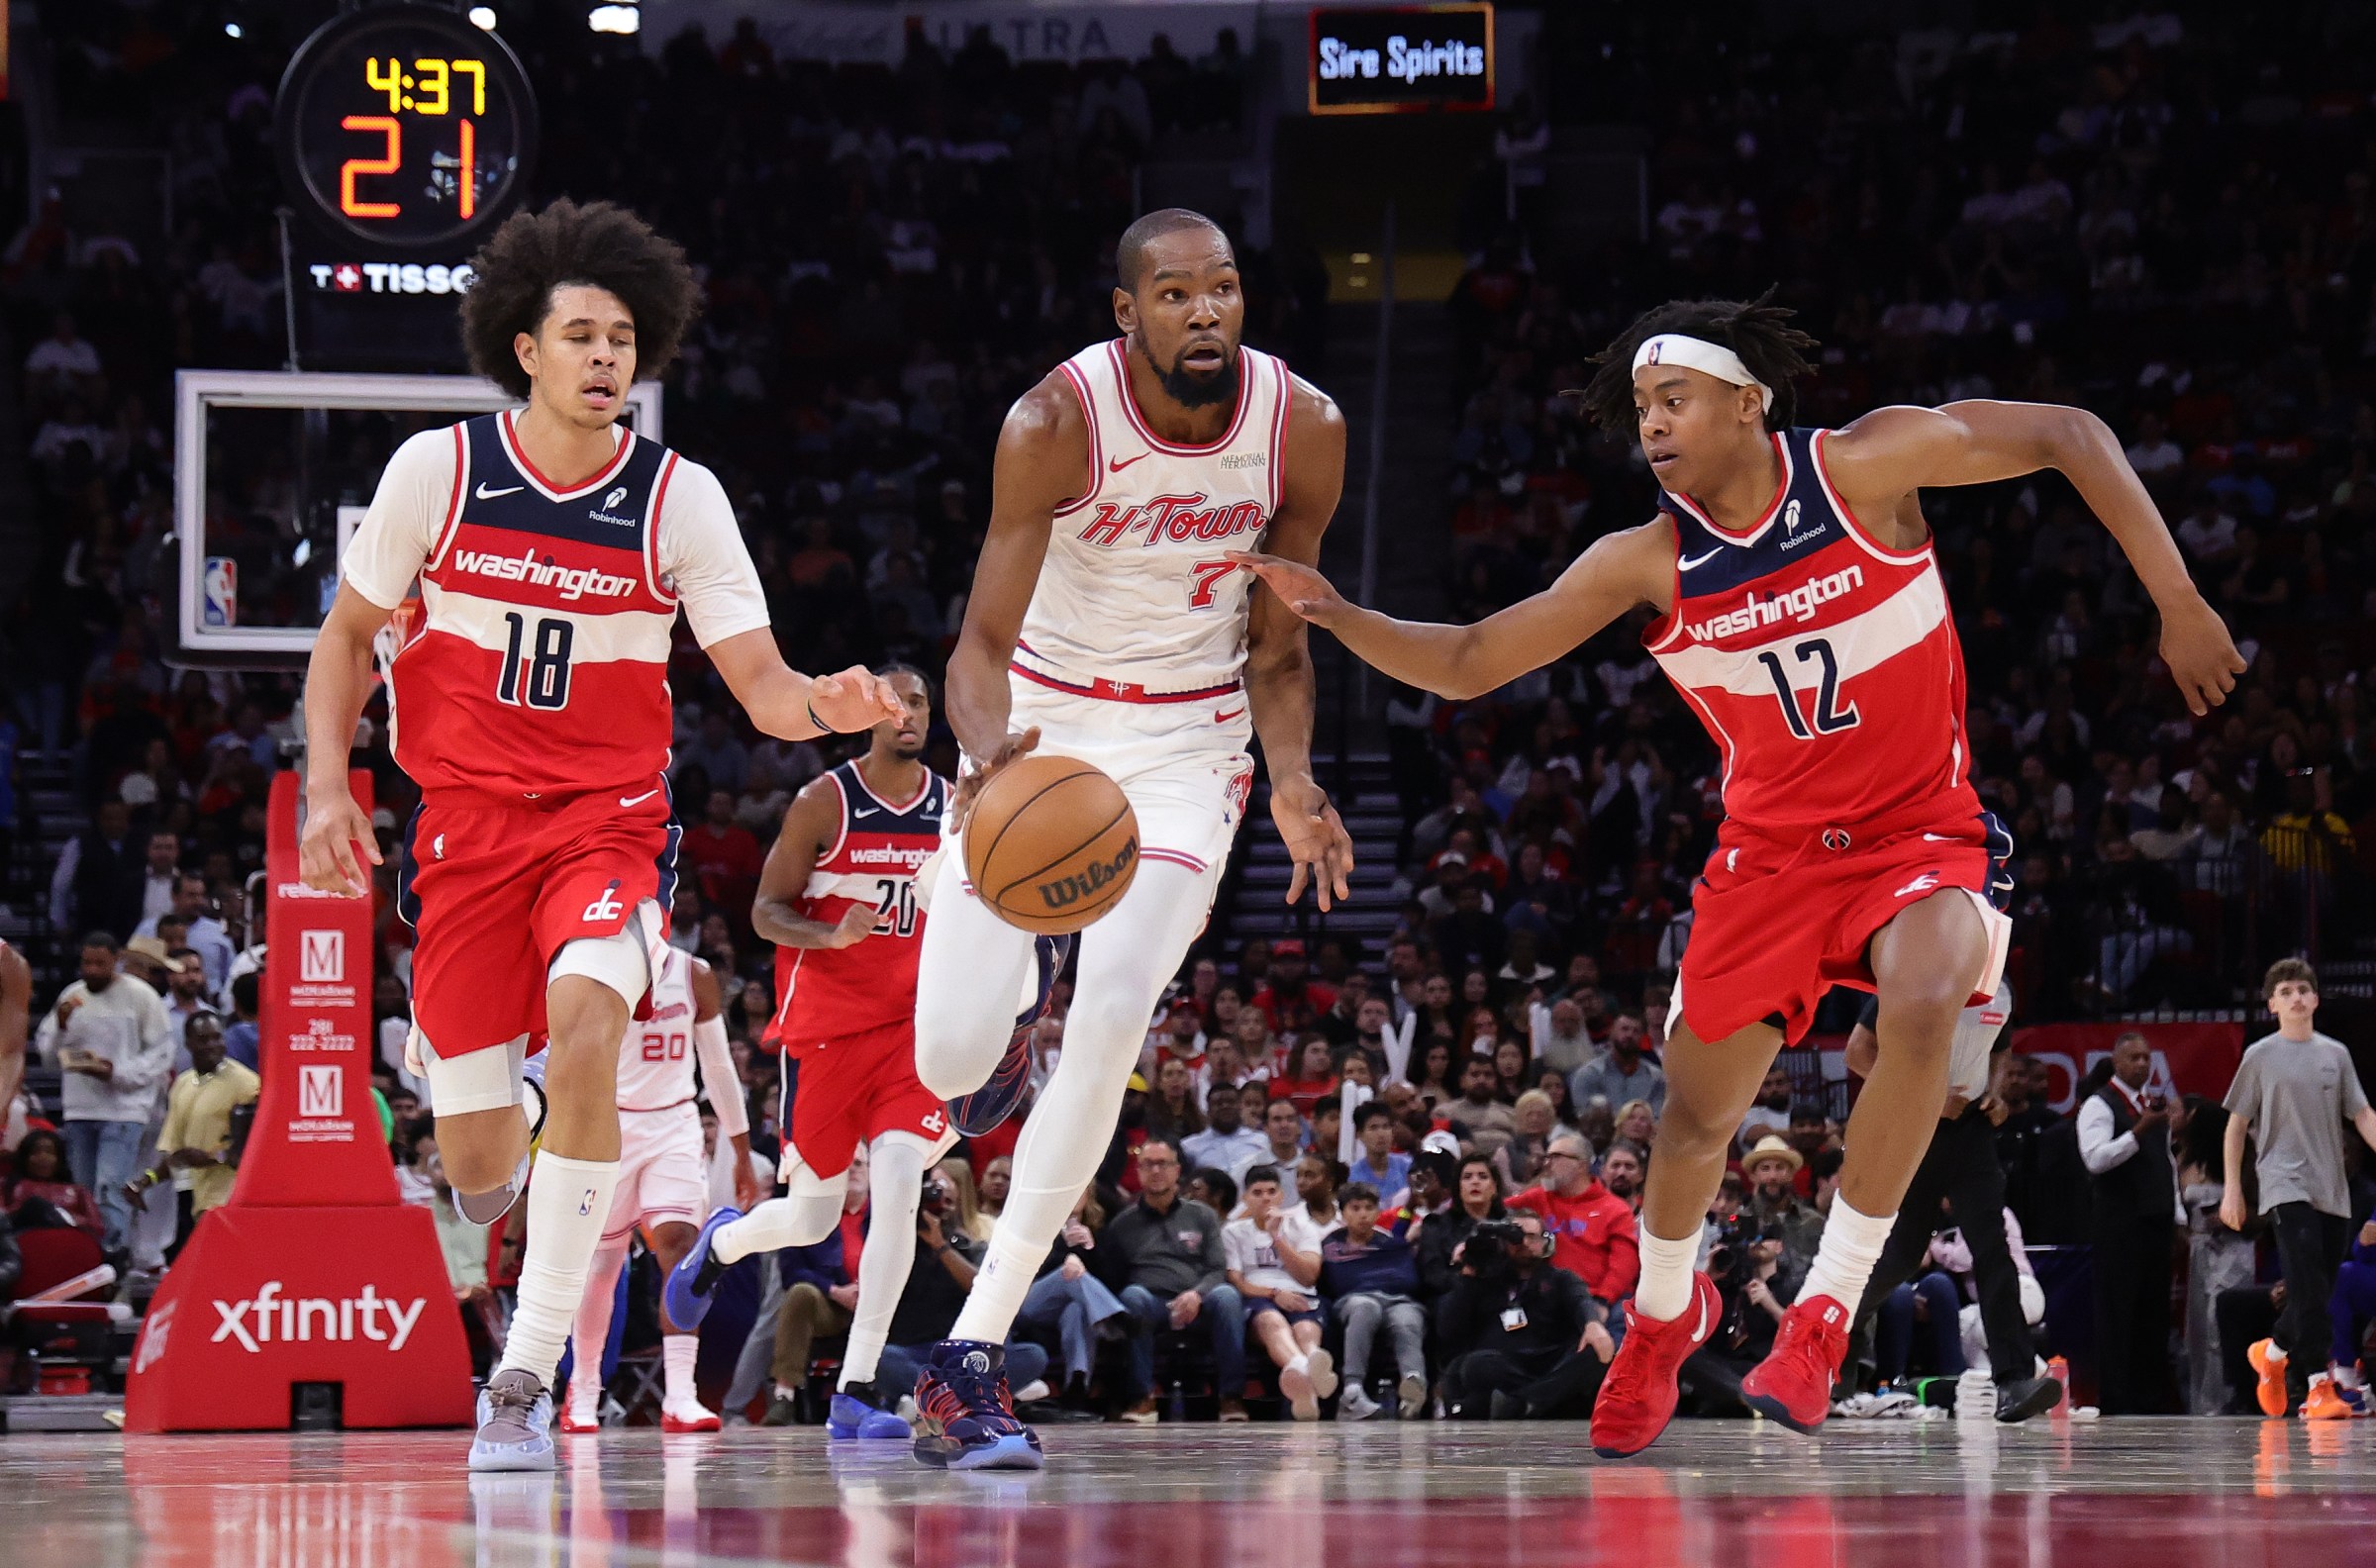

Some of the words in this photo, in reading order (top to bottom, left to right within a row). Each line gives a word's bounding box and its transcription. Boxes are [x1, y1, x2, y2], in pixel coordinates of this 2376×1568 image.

[939, 17, 1110, 54] UTRA
[1319, 37, 1380, 79] Sire
[1386, 36, 1484, 85] Spirits
[366, 57, 485, 116] 4:37
[341, 116, 474, 220] 21
[362, 263, 478, 294] TISSO
[1220, 458, 1266, 470] HERMANN
[1222, 451, 1266, 463] MEMORIAL
[589, 510, 636, 528] Robinhood
[1076, 491, 1268, 546] H-Town
[1779, 523, 1827, 551] Robinhood
[454, 547, 638, 600] washington
[1187, 560, 1240, 613] 7
[1684, 564, 1864, 641] washington
[496, 611, 574, 712] 18
[1757, 638, 1861, 740] 12
[1038, 834, 1138, 909] Wilson
[869, 879, 918, 937] 20
[642, 1033, 686, 1062] 20
[210, 1280, 428, 1353] xfinity
